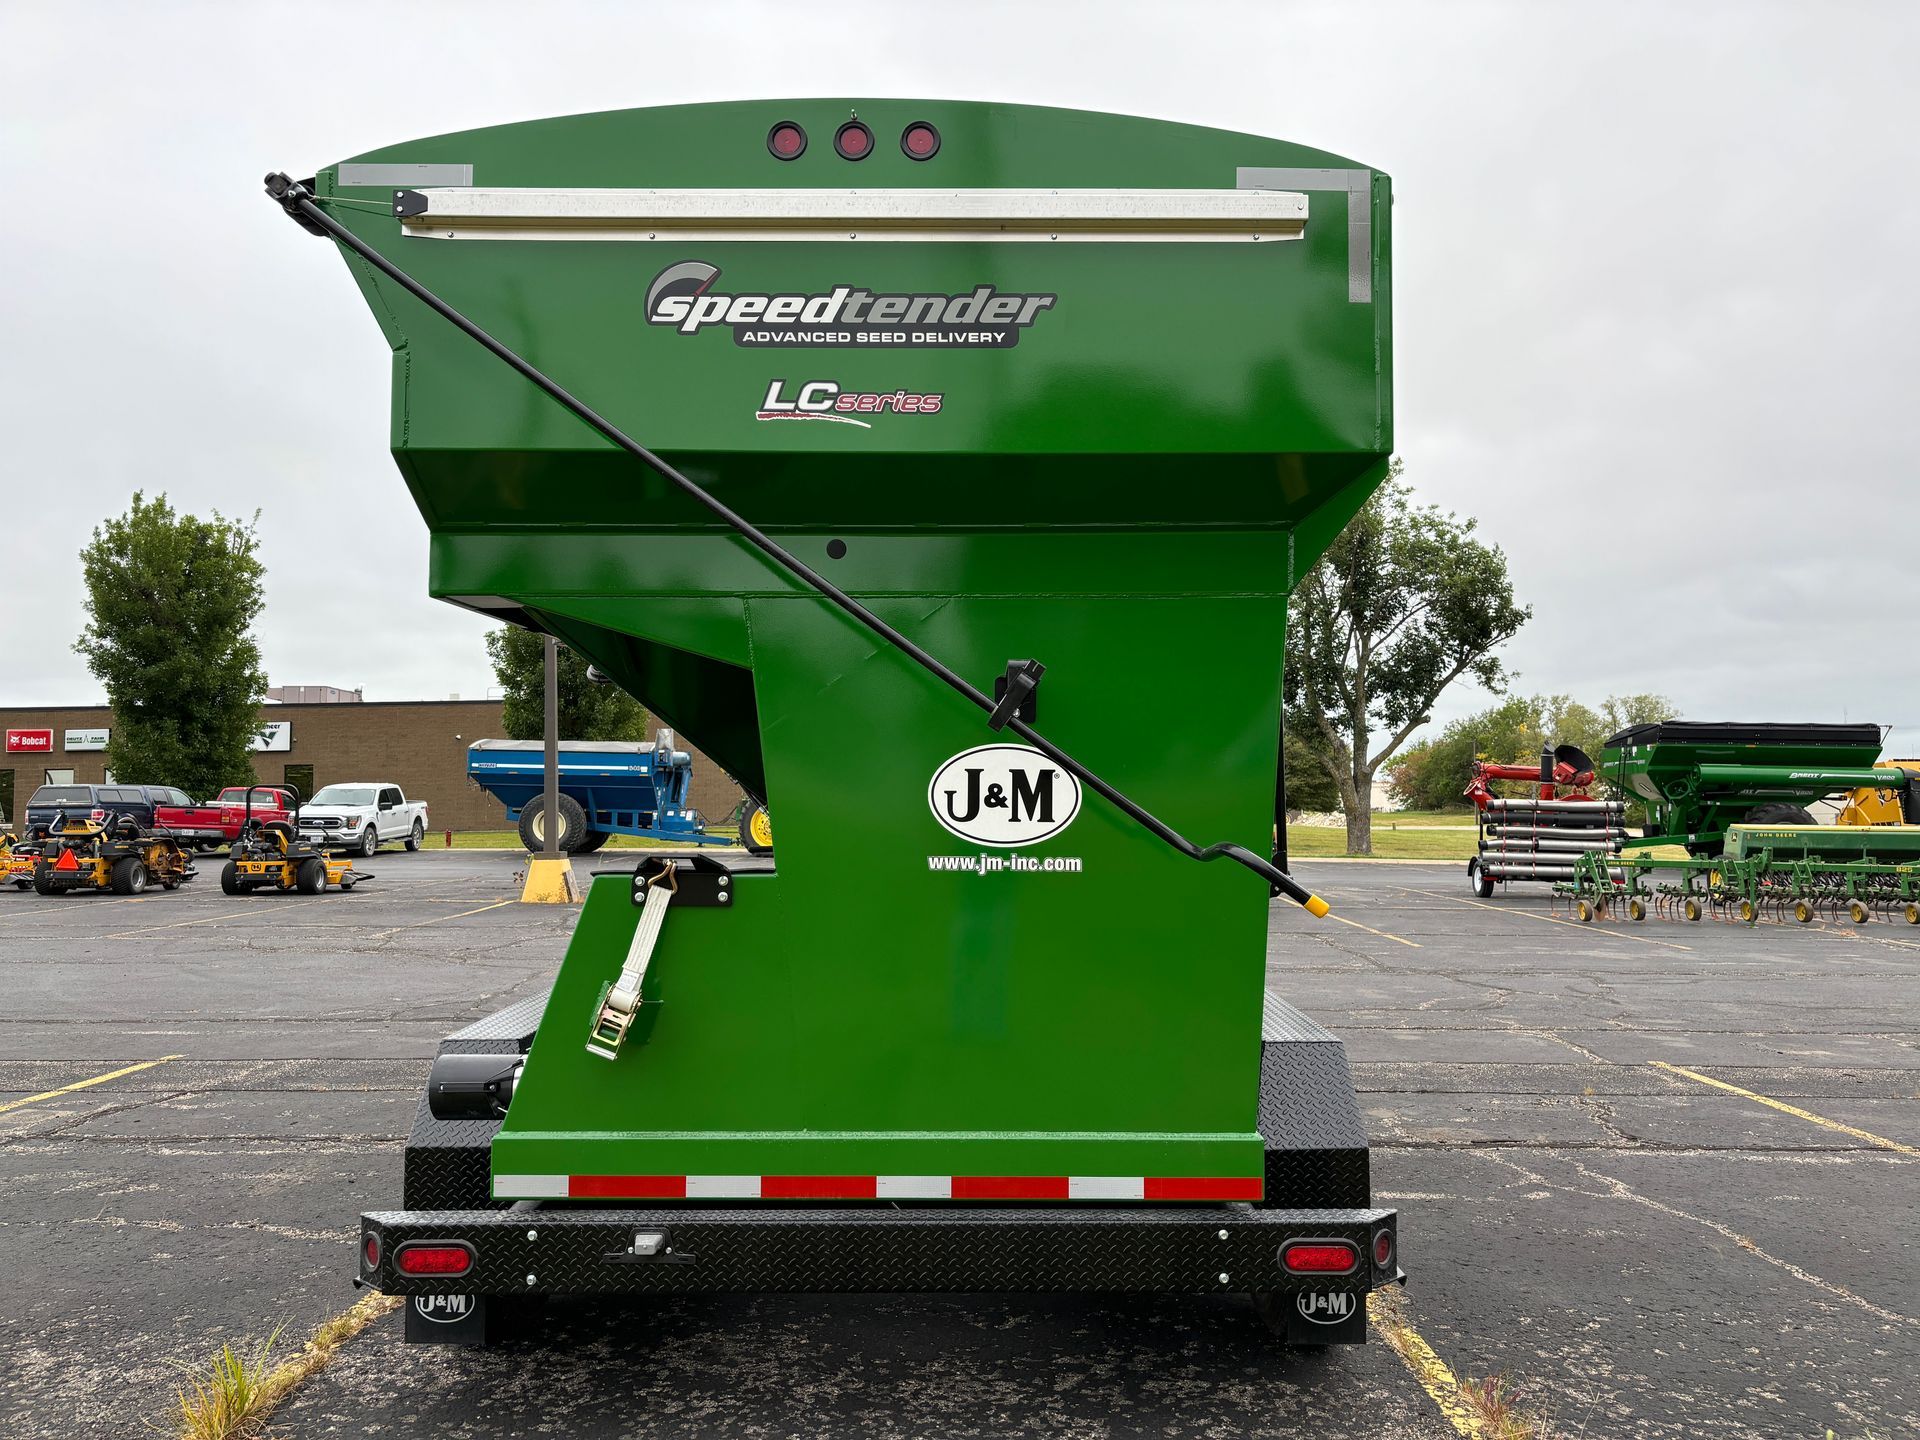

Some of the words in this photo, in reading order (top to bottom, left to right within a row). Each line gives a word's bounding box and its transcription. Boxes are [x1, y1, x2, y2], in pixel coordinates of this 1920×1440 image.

[650, 286, 1055, 332] speedtender
[742, 331, 851, 343] ADVANCED
[856, 331, 906, 343] SEED
[911, 331, 1007, 343] DELIVERY
[21, 736, 47, 746] Bobcat
[927, 854, 1083, 876] www.jm-inc.com
[418, 1294, 467, 1314] J&M
[1299, 1292, 1348, 1315] J&M
